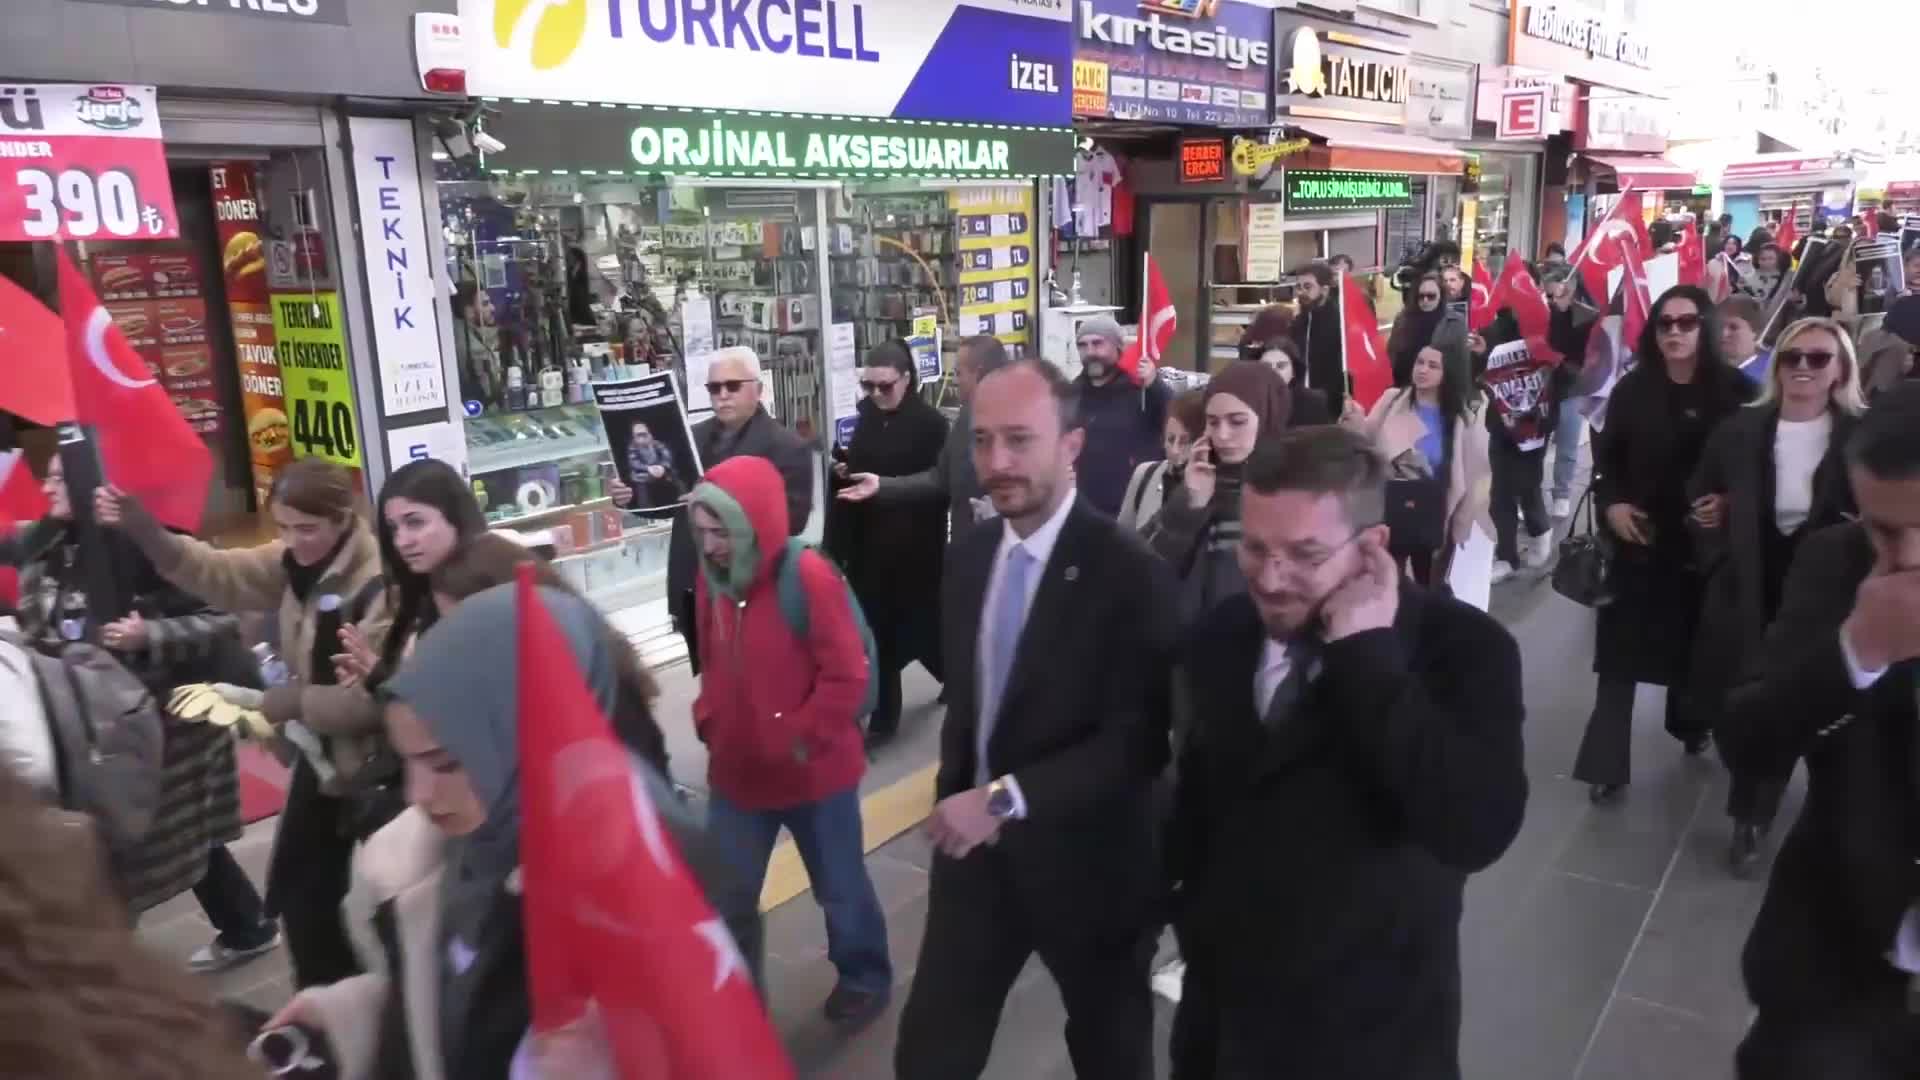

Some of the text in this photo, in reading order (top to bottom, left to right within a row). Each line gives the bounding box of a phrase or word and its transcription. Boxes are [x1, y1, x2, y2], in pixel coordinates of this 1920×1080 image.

[1010, 54, 1058, 93] İZEL
[1327, 55, 1410, 105] TATLICIM
[1509, 100, 1535, 130] E
[630, 120, 1009, 171] ORJİNAL AKSESUARLAR
[212, 168, 228, 189] ET
[1186, 160, 1219, 176] ERCAN
[217, 197, 258, 221] DÖNER
[960, 218, 970, 235] 5
[1013, 248, 1025, 264] TL
[1014, 282, 1025, 297] TL
[239, 344, 277, 365] TAVUK
[292, 337, 343, 371] İSKENDER
[242, 370, 283, 397] DÖNER
[294, 398, 356, 459] 440
